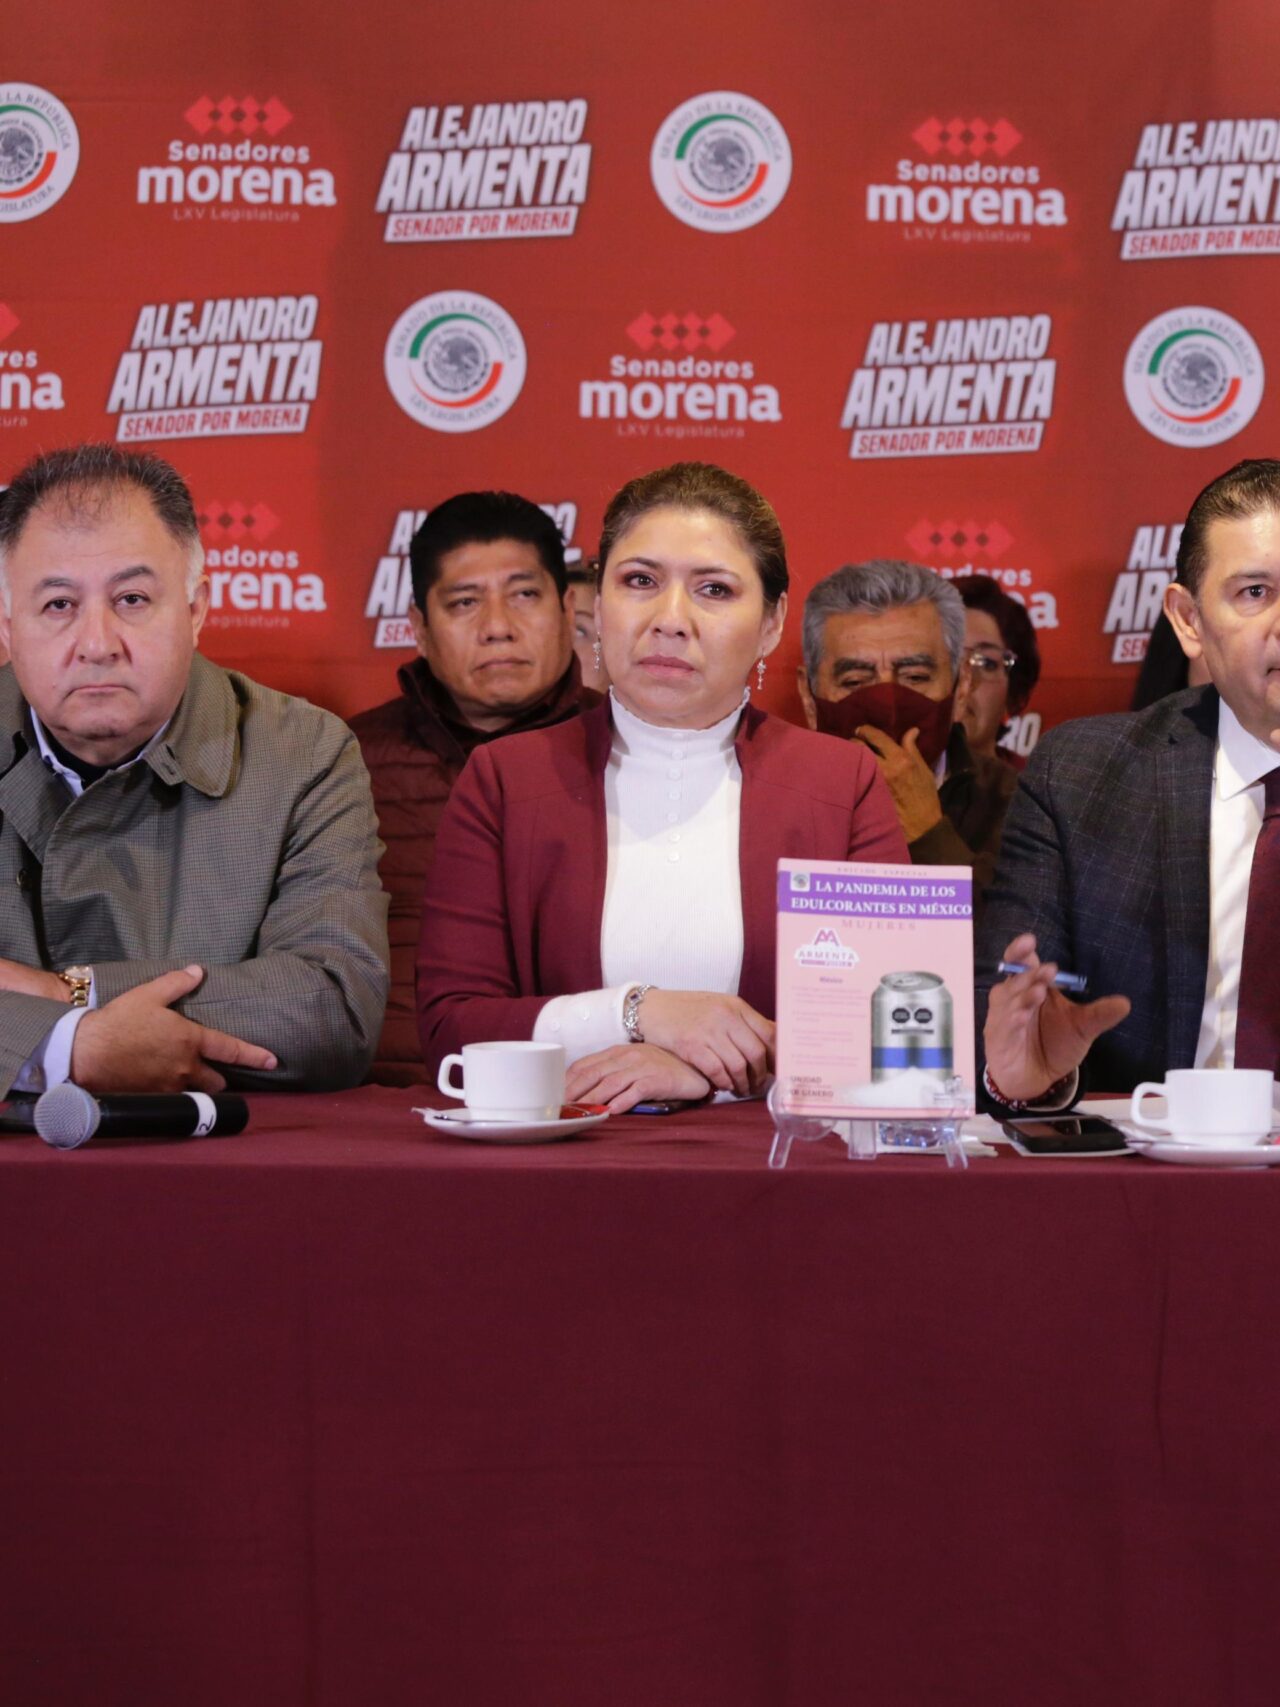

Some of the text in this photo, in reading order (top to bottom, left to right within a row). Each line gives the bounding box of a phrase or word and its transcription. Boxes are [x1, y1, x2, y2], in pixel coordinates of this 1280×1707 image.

[401, 99, 588, 150] ALEJANDRO
[169, 139, 310, 164] Senadores
[376, 144, 592, 212] ARMENTA
[897, 159, 1040, 184] Senadores
[137, 165, 337, 207] morena
[173, 207, 300, 222] LXV Legislatura
[866, 185, 1068, 226] morena
[393, 211, 570, 237] SENADOR POR MORENA
[903, 227, 1031, 243] LXV Legislatura
[1128, 232, 1201, 254] SENADOR
[1206, 230, 1236, 250] POR
[131, 295, 318, 350] ALEJANDRO
[864, 314, 1051, 367] ALEJANDRO
[107, 341, 323, 414] ARMENTA
[610, 355, 754, 379] Senadores
[579, 382, 782, 422] morena
[841, 360, 1056, 428] ARMENTA
[124, 408, 301, 437] SENADOR POR MORENA
[616, 424, 744, 439] LXV Legislatura
[858, 427, 1035, 453] SENADOR POR MORENA
[203, 545, 299, 569] adores
[209, 571, 327, 612] rena
[816, 881, 956, 897] LA PANDEMIA DE LOS
[791, 897, 972, 915] EDULCORANTES EN MÉXICO
[842, 919, 916, 931] MUJERES
[798, 951, 855, 960] ARMENTA
